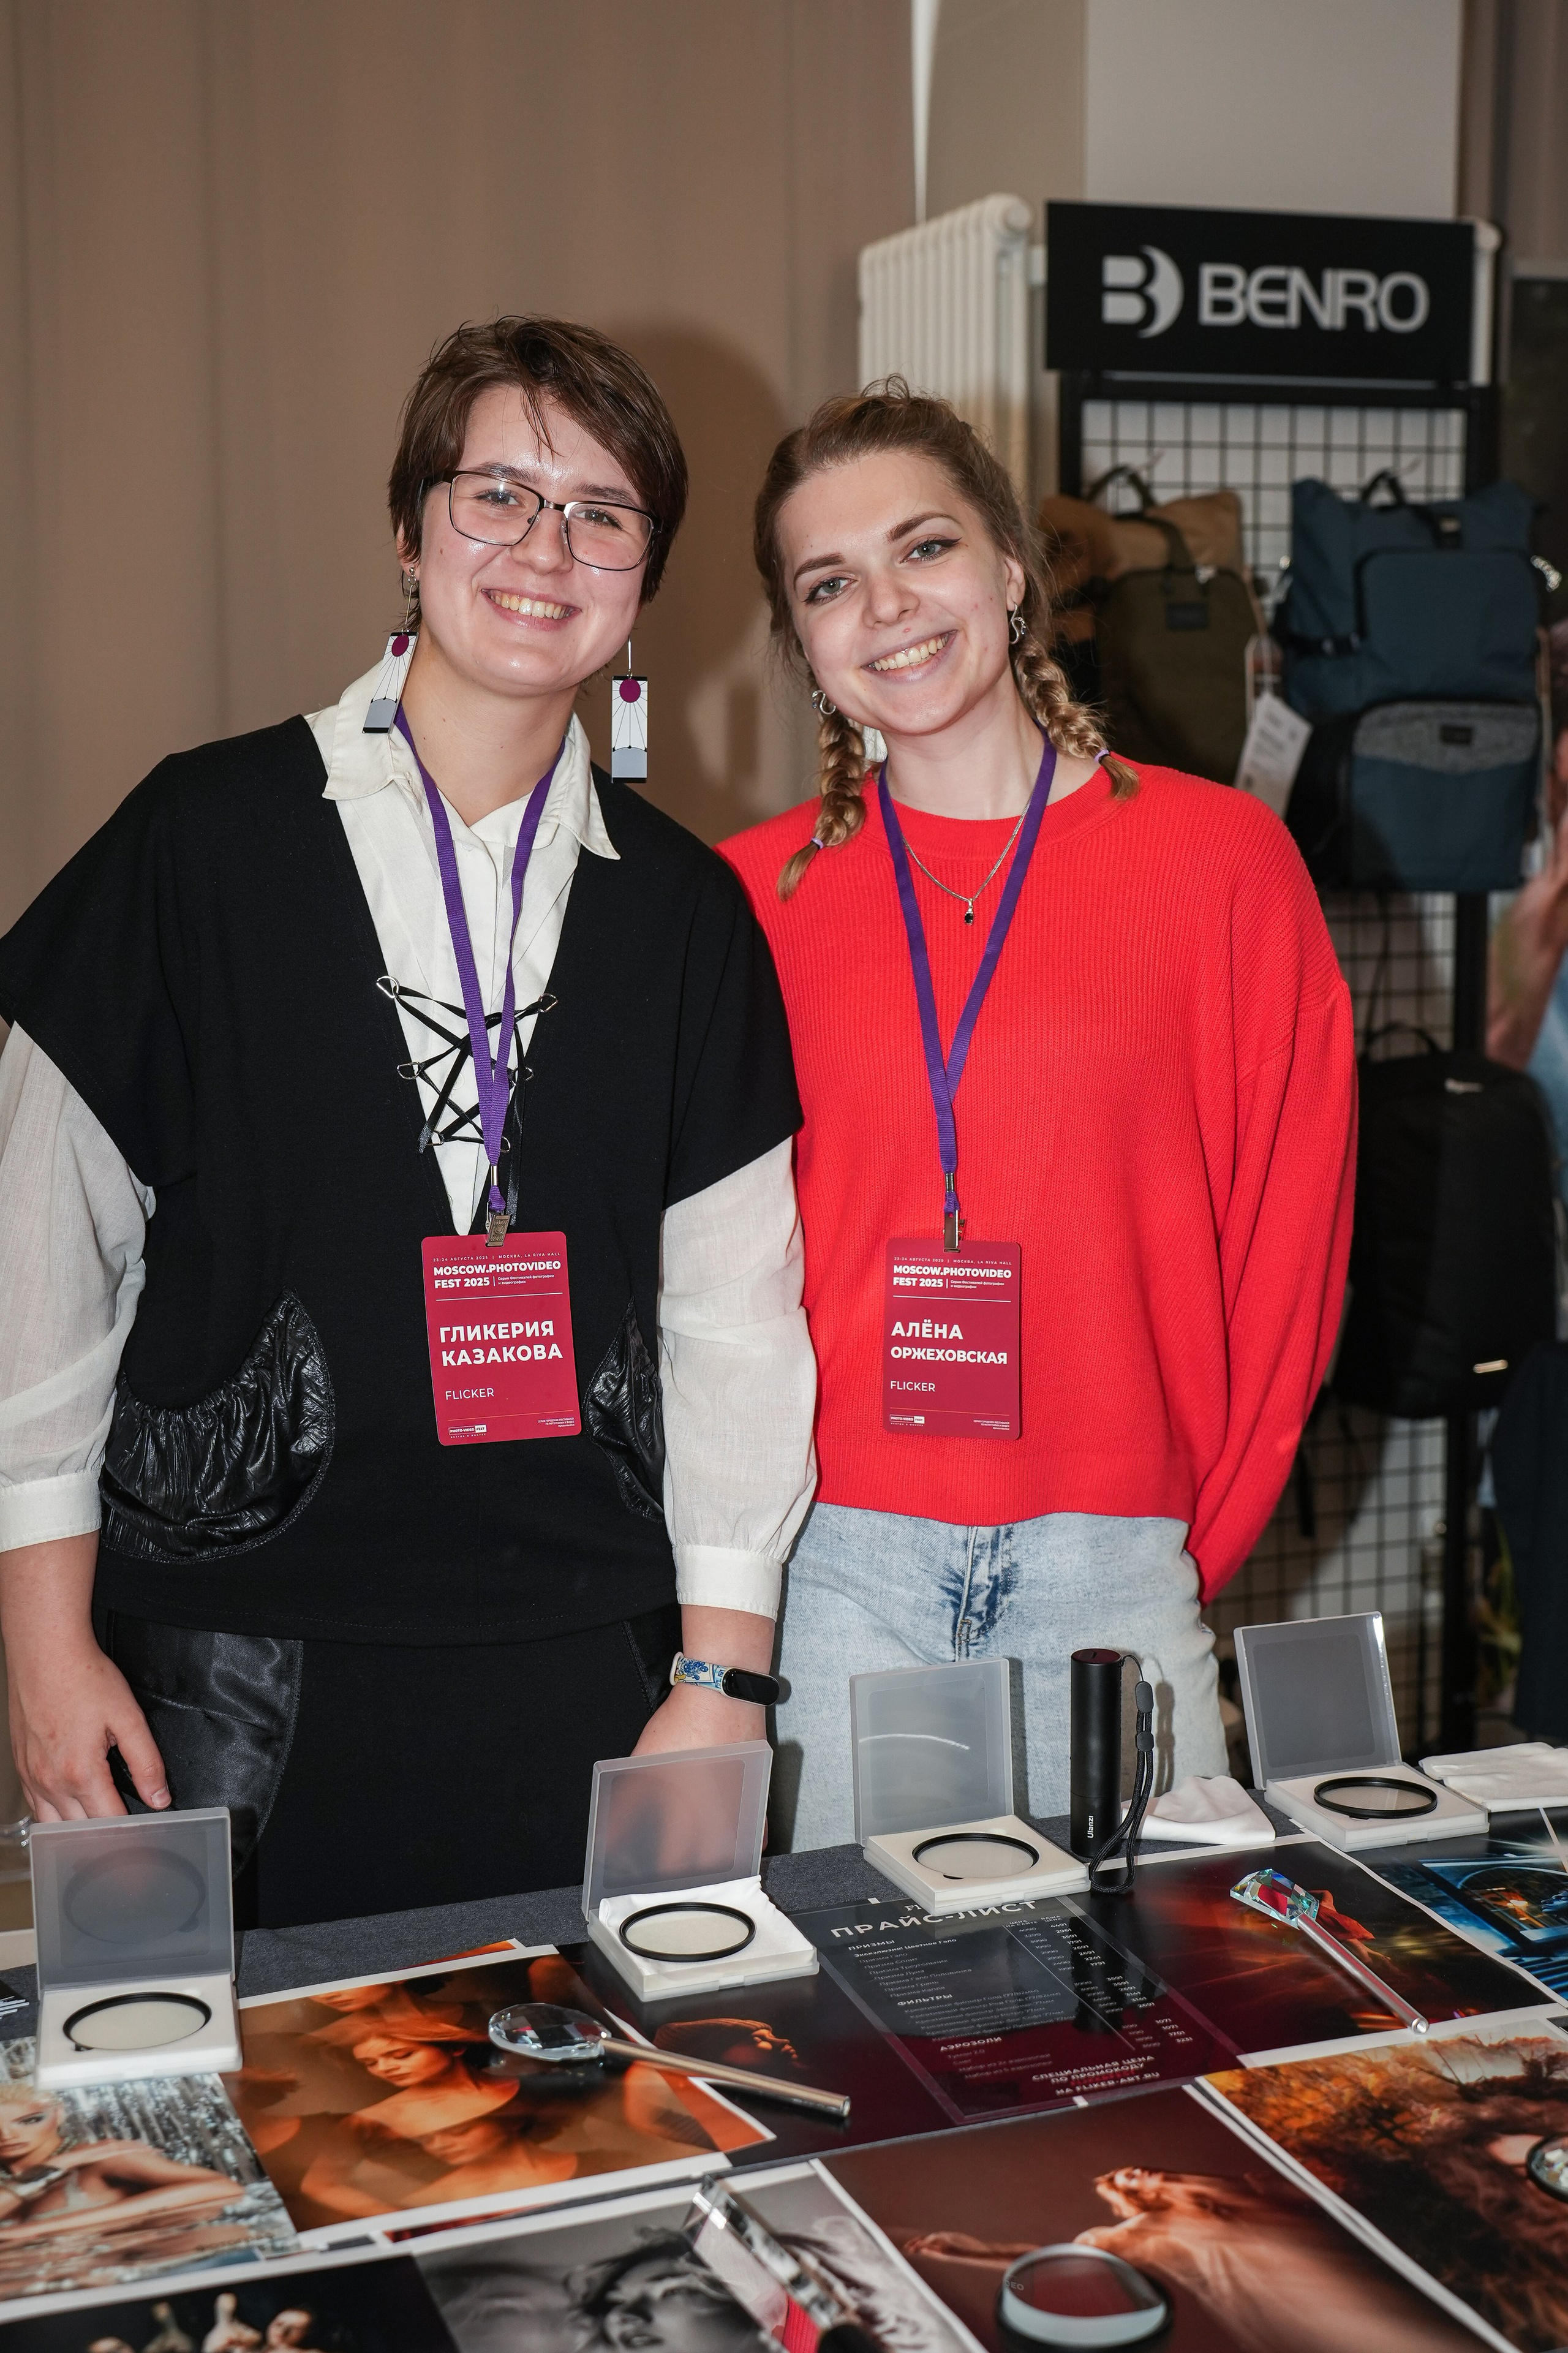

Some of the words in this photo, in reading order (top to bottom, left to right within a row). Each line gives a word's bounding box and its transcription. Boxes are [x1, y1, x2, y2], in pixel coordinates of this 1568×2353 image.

[1198, 262, 1430, 334] BENRO
[434, 1260, 561, 1276] MOSCOW.PHOTOVIDEO
[893, 1265, 1012, 1278] MOSCOW.PHOTOVIDEO
[434, 1278, 461, 1289] FEST
[464, 1277, 490, 1287] 2025
[893, 1277, 918, 1286] FEST
[919, 1278, 943, 1287] 2025
[440, 1320, 554, 1343] ГЛИКЕРИЯ
[891, 1319, 963, 1340] АЛЁНА
[442, 1343, 563, 1367] КАЗАКОВА
[891, 1346, 1008, 1364] ОРЖЕХОВСКАЯ
[890, 1380, 935, 1392] FLICKER
[445, 1388, 494, 1400] FLICKER
[831, 1901, 1036, 1938] ПРАЙС-ЛИСТ
[848, 1940, 895, 1951] ПРИЗМЫ
[900, 1960, 948, 1969] Треугольник
[930, 1969, 972, 1977] Половинка
[897, 1994, 952, 2005] ФИЛЬТРЫ
[940, 2037, 1002, 2052] АЭРОЗОЛИ
[1032, 2061, 1119, 2080] СПЕЦИАЛЬНАЯ
[1122, 2055, 1155, 2064] ЦЕНА
[1071, 2063, 1144, 2080] ПРОМОКОДУ
